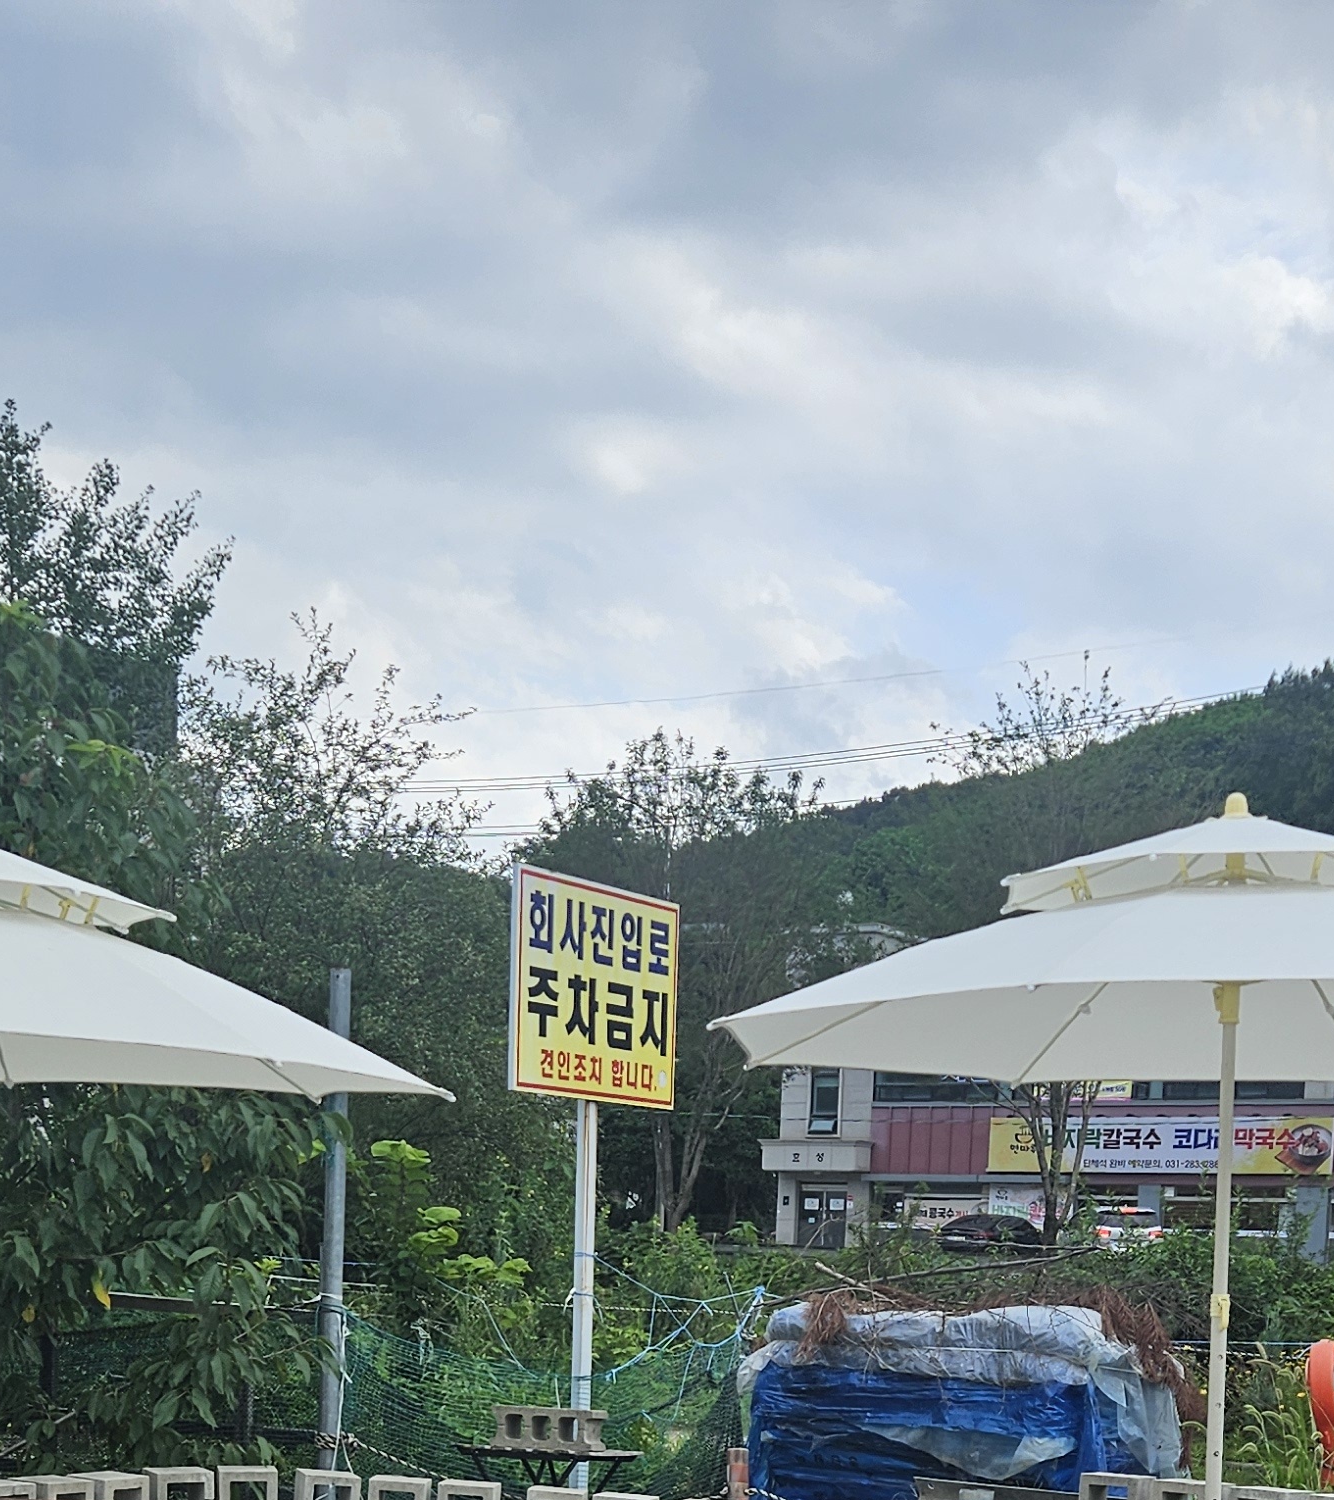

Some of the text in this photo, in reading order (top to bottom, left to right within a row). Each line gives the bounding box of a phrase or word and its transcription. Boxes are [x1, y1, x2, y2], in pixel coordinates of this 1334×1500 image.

[529, 890, 670, 976] 회사진입로
[528, 965, 669, 1057] 주차금지
[540, 1048, 602, 1085] 견인조치
[1083, 1159, 1107, 1169] 단체석
[1109, 1159, 1126, 1169] 완비
